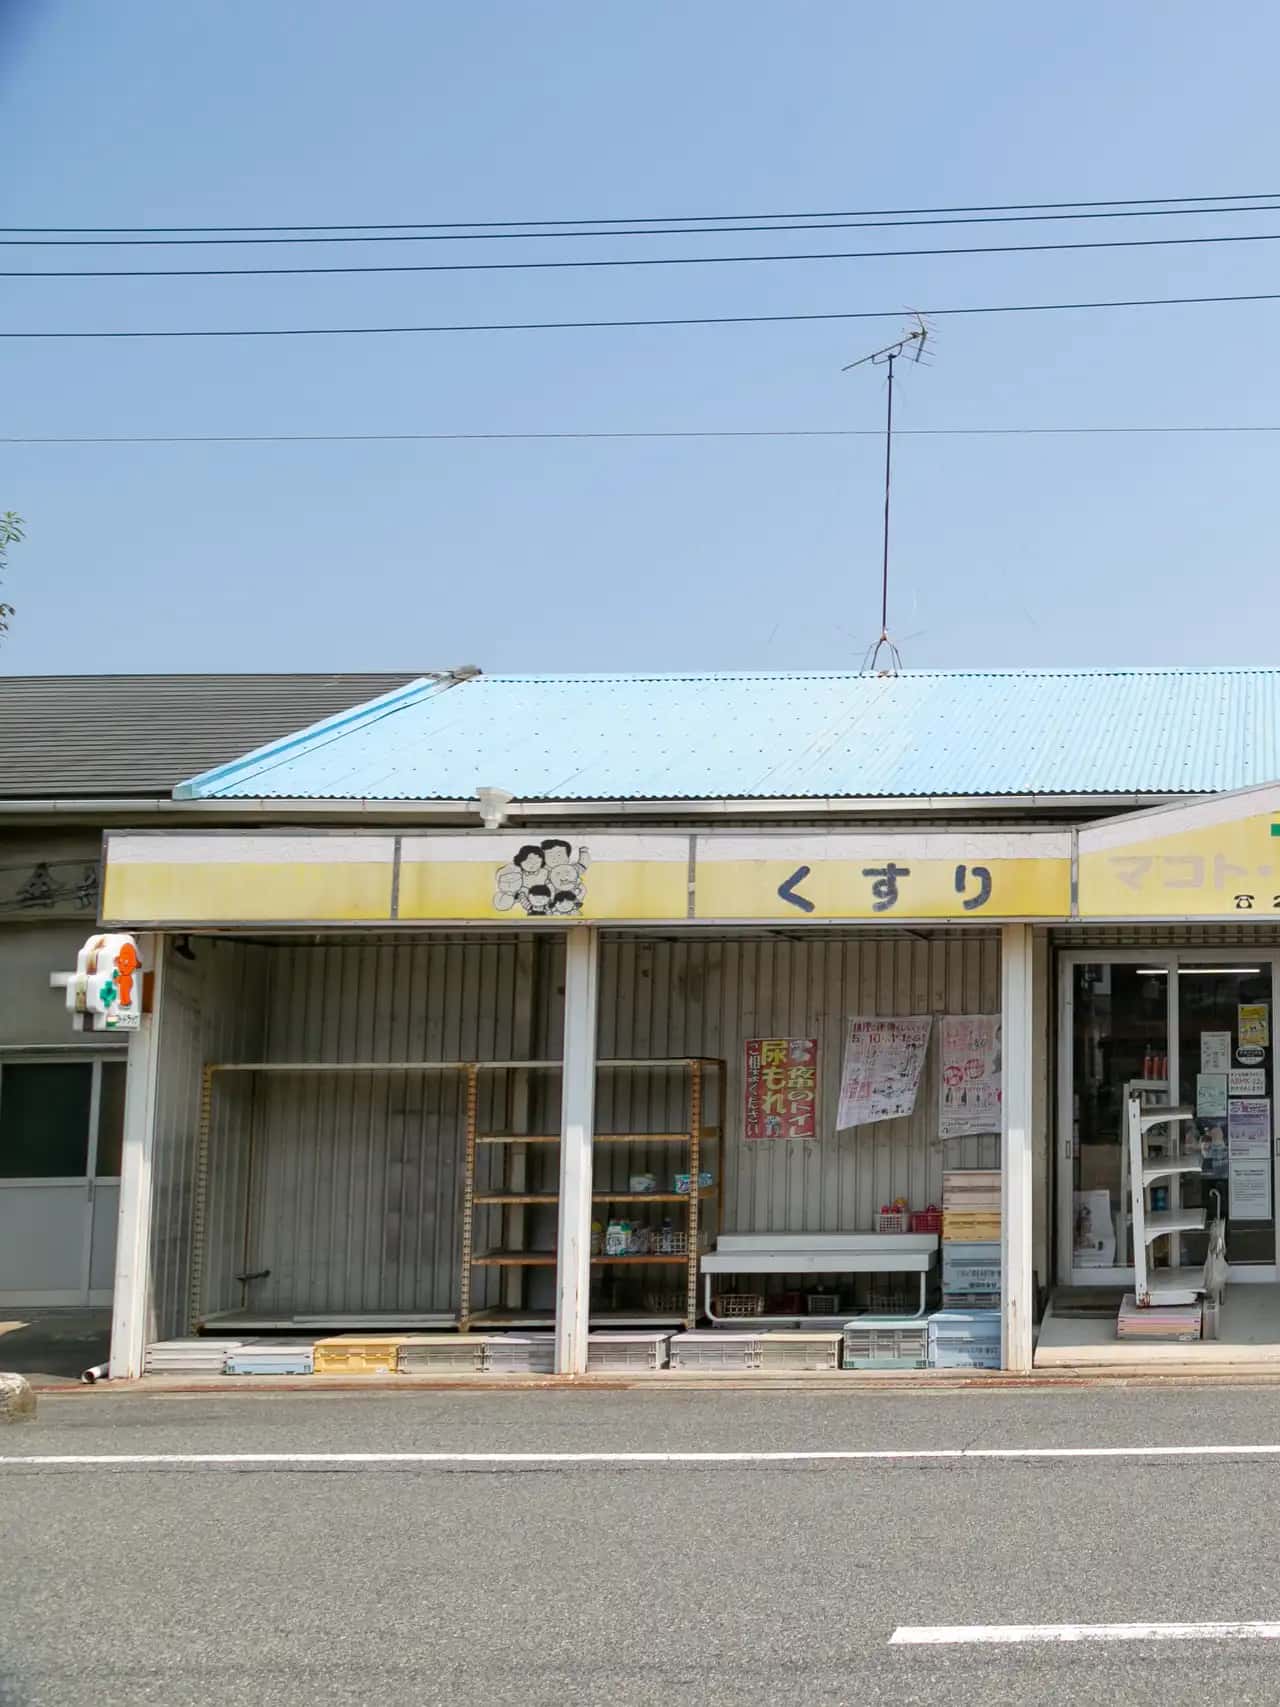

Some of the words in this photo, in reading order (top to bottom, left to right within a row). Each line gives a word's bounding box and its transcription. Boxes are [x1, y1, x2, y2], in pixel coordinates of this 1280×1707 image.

[777, 863, 992, 913] くすり
[761, 1041, 788, 1114] 尿もれ
